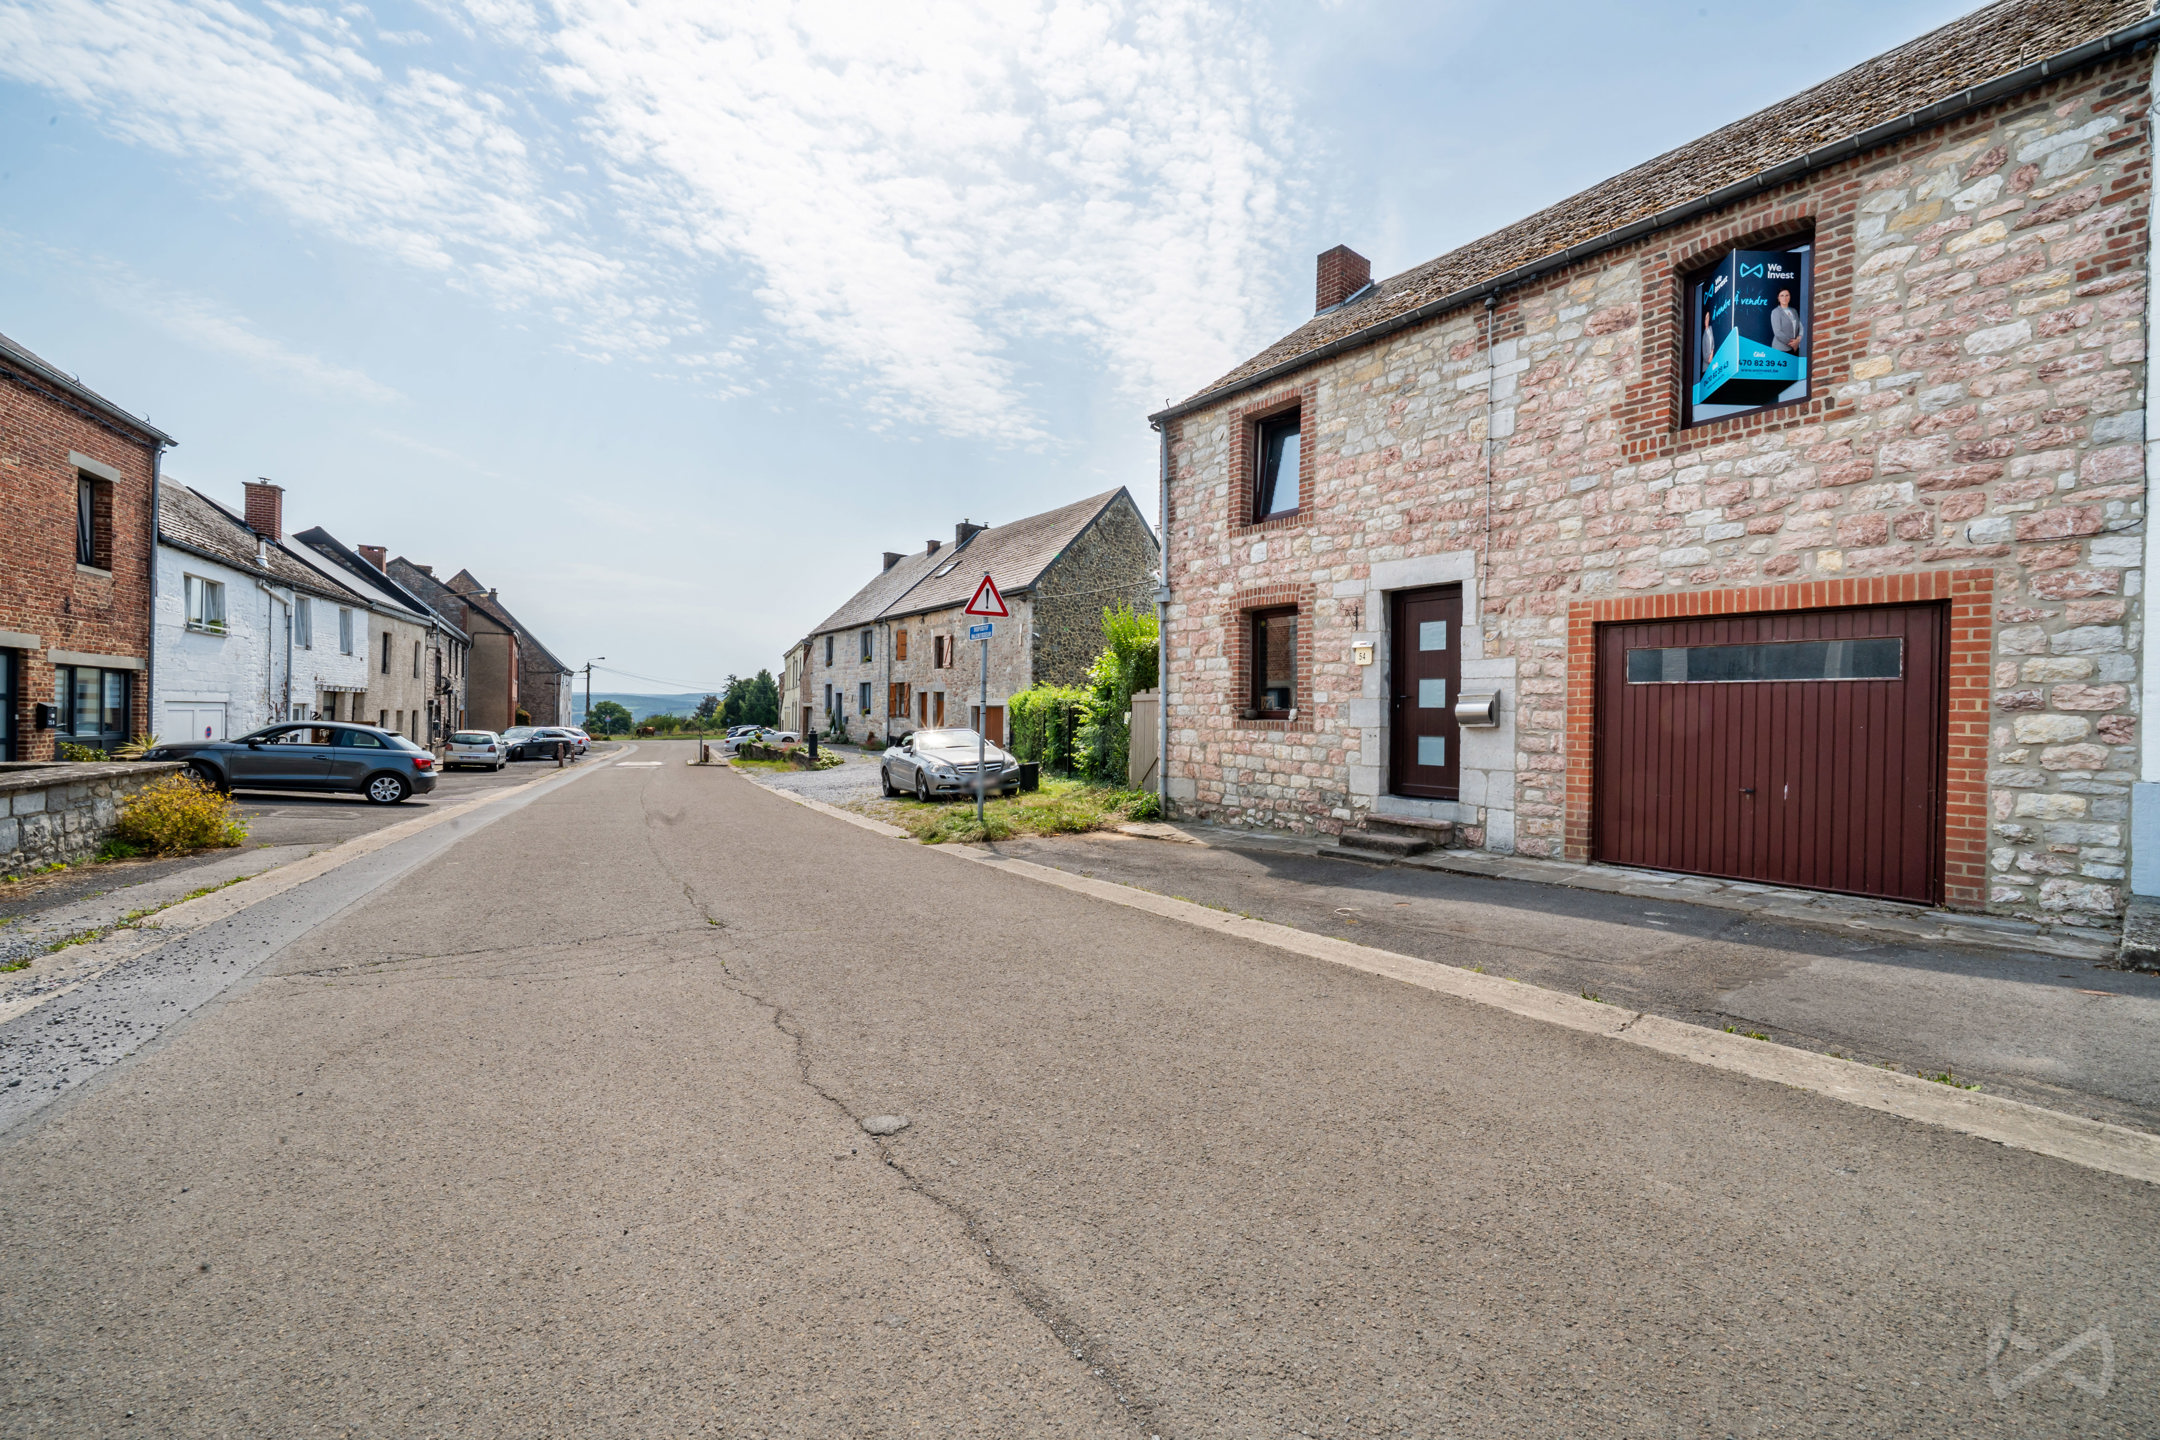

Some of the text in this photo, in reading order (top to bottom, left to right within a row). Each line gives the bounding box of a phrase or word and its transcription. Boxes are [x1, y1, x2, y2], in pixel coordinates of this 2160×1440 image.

[1767, 263, 1782, 272] We
[1767, 271, 1795, 279] Invest
[1741, 295, 1768, 306] vendre
[1738, 359, 1752, 367] 470
[1754, 359, 1764, 367] 82
[1776, 360, 1788, 368] 43
[1359, 652, 1366, 661] 54
